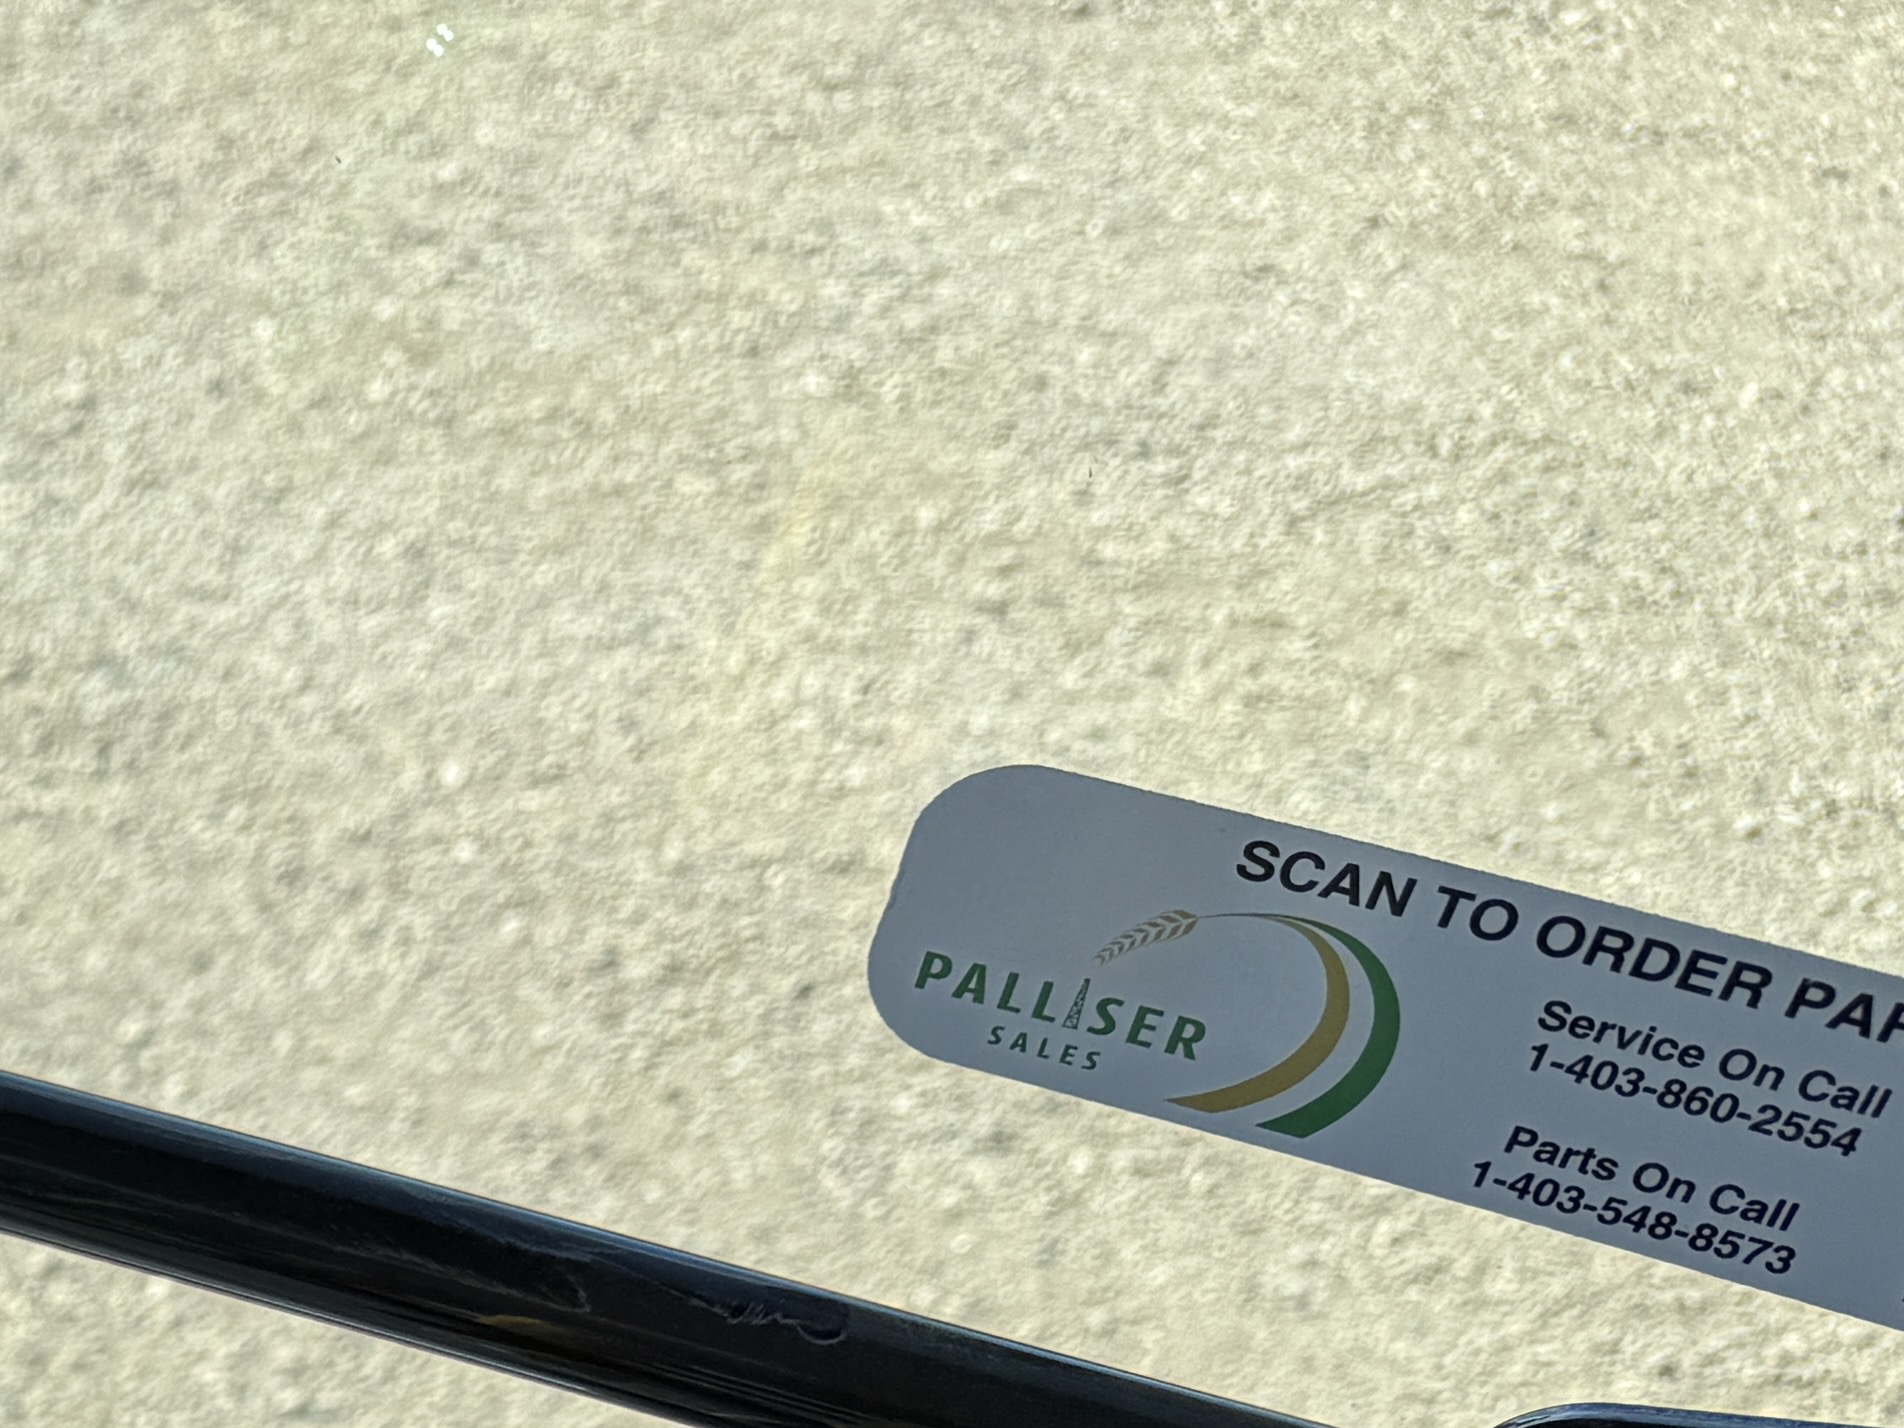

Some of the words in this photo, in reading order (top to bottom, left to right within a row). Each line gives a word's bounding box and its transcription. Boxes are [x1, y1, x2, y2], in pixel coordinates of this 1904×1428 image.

[1236, 839, 1417, 918] SCAN
[1435, 884, 1520, 944] TO
[1534, 914, 1773, 1011] ORDER
[914, 951, 1208, 1061] PALLISER
[988, 1024, 1101, 1072] SALES
[1537, 998, 1706, 1069] Service
[1718, 1047, 1786, 1091] On
[1798, 1069, 1893, 1120] Call
[1529, 1042, 1862, 1156] 1-403-860-2554
[1471, 1159, 1796, 1274] 1-403-548-8573
[1504, 1125, 1619, 1182] Parts
[1632, 1162, 1695, 1204] On
[1709, 1183, 1800, 1232] Call
